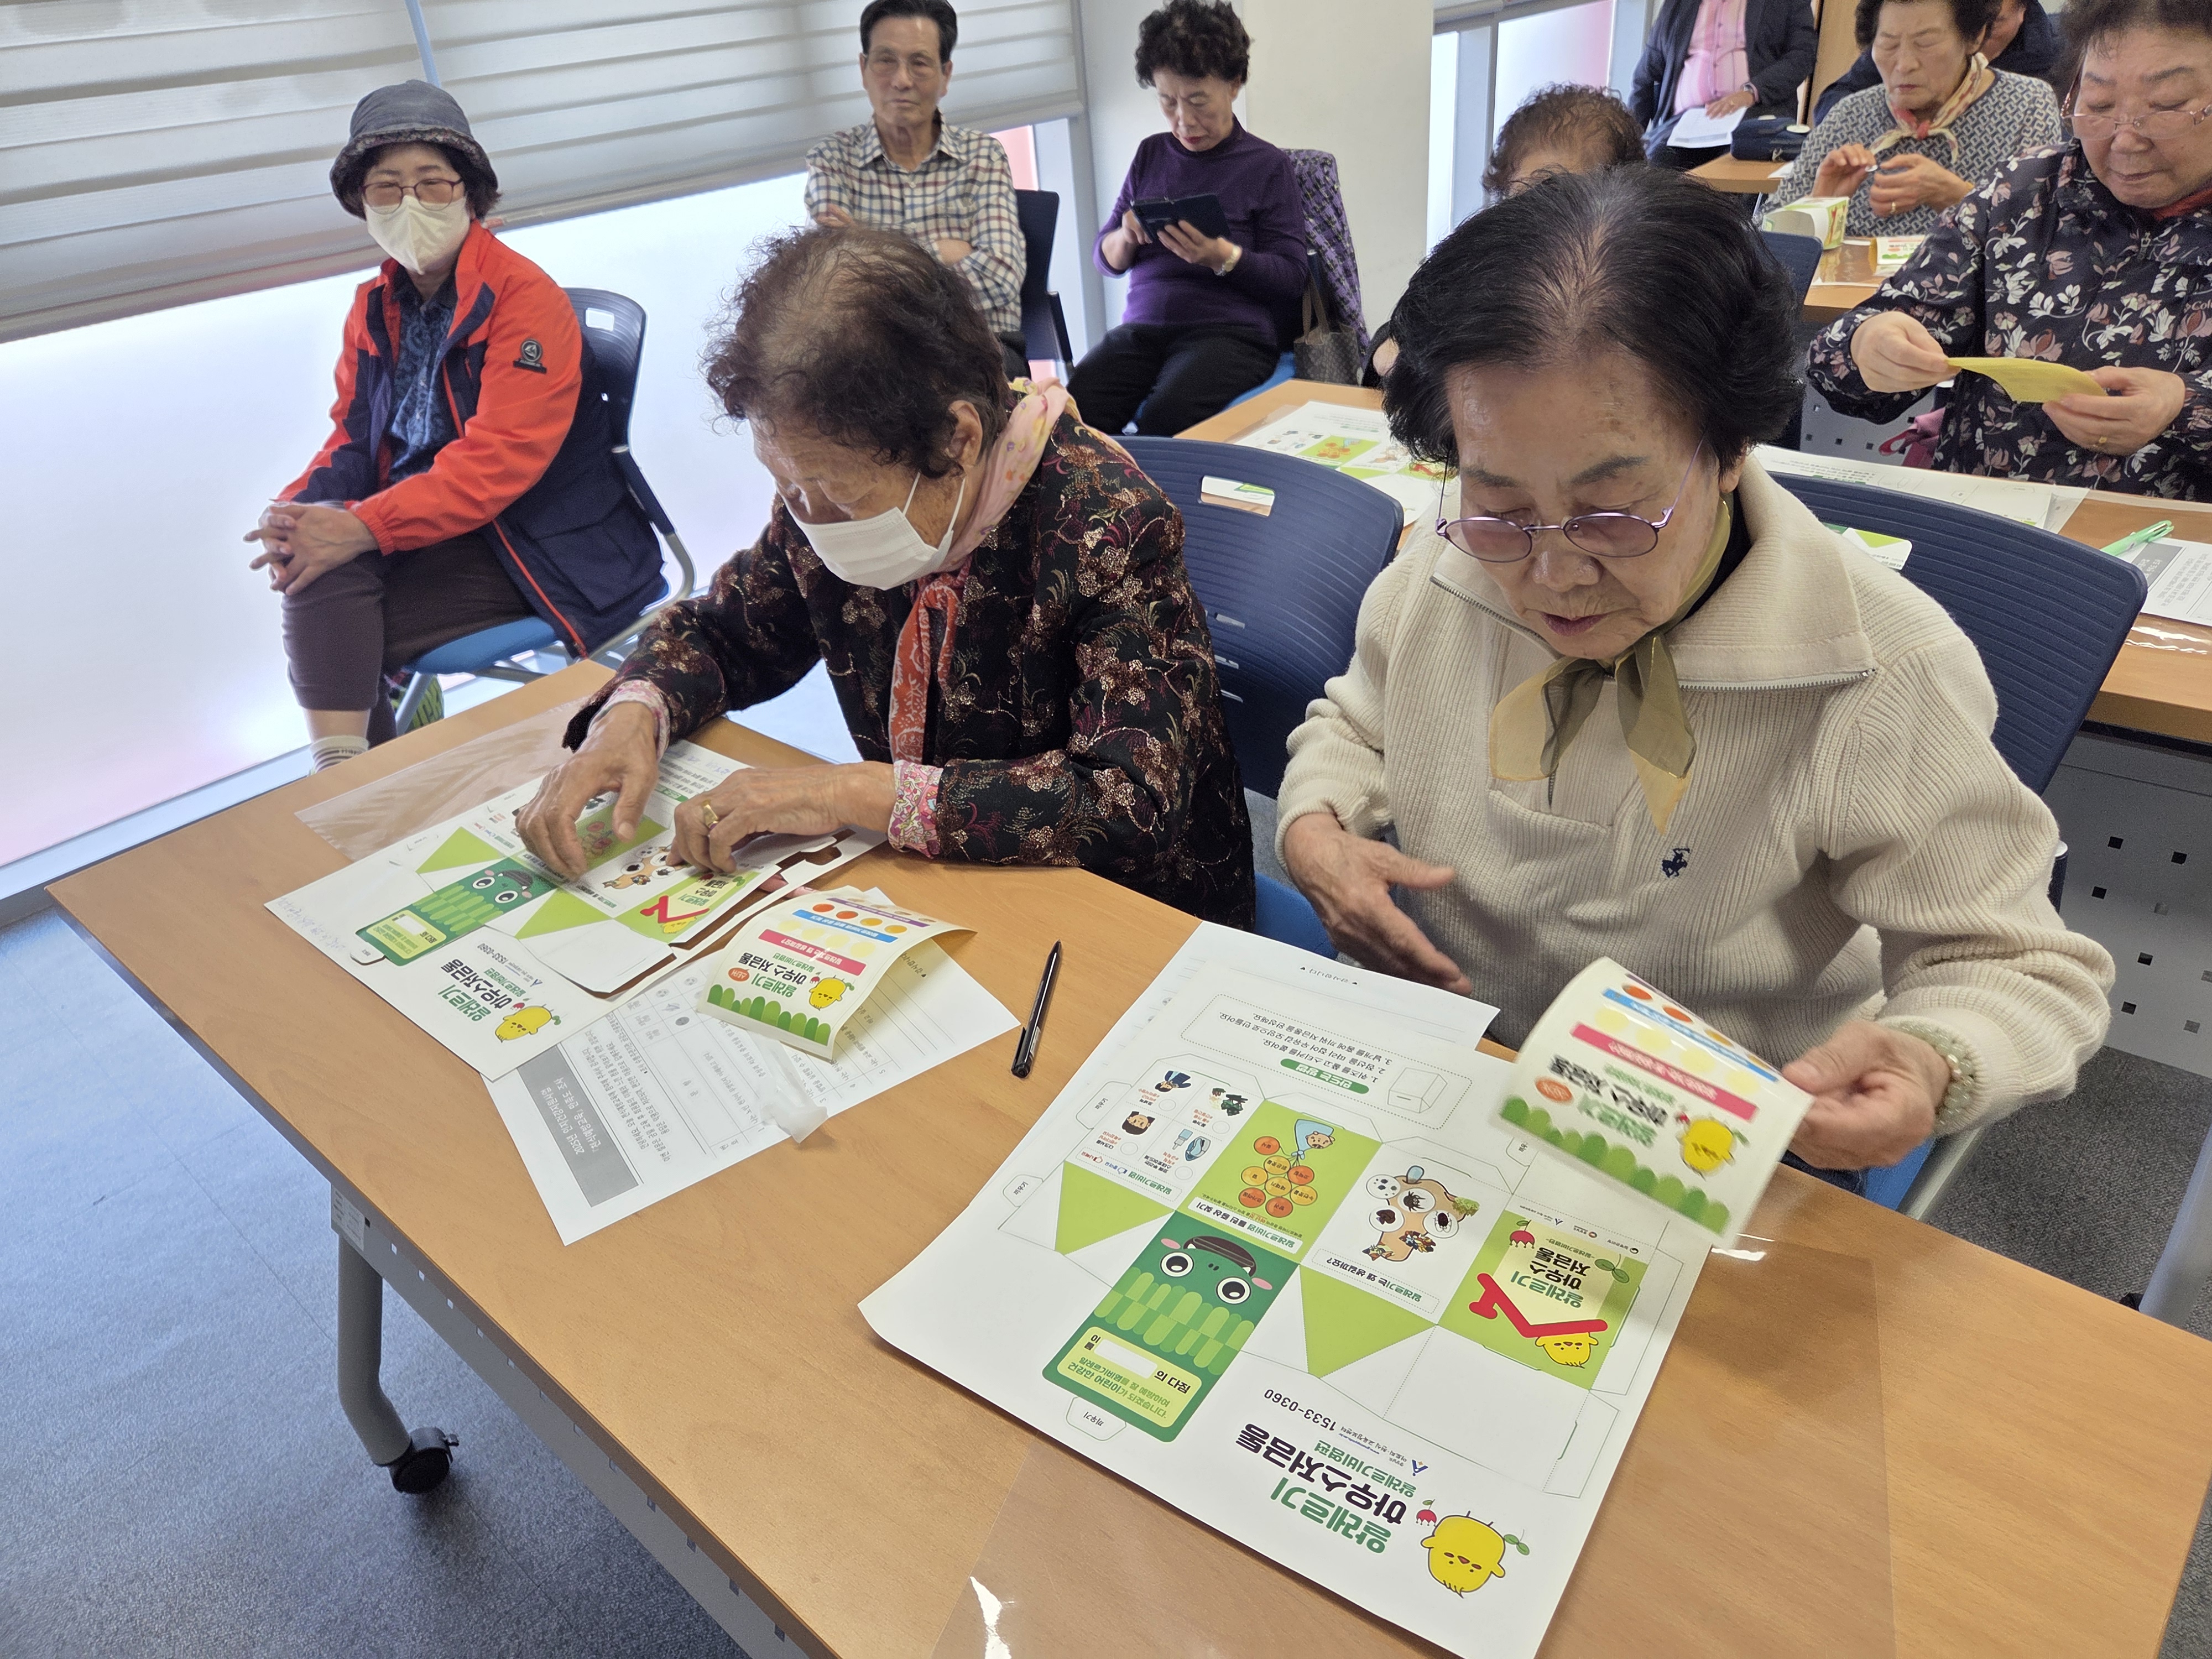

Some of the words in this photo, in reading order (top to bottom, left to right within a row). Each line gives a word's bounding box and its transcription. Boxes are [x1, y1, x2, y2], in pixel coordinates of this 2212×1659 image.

[2192, 299, 2212, 310] Col
[738, 953, 774, 972] 저금통
[773, 953, 815, 972] 알레르기비염편
[484, 968, 526, 997] 알레르기비염편
[774, 965, 807, 984] 하우스
[442, 959, 517, 1009] 하우스저금통
[752, 973, 797, 997] 알레르기
[438, 984, 491, 1021] 알레르기
[1220, 1013, 1251, 1028] 만들어요.
[1254, 1014, 1285, 1029] 완성해요.
[1252, 1025, 1284, 1039] 모양으로
[1286, 1025, 1318, 1040] 저금통을
[1264, 1039, 1288, 1052] 붙여요.
[1285, 1036, 1309, 1047] 우유갑
[1310, 1045, 1327, 1055] 접어
[1319, 1037, 1337, 1046] 끼워
[1289, 1048, 1323, 1063] 스티커를
[1328, 1051, 1345, 1061] 따라
[1349, 1058, 1375, 1071] 점선을
[1356, 1050, 1382, 1062] 날개를
[1296, 1064, 1318, 1076] 방법
[1323, 1061, 1340, 1070] 풀고
[1342, 1067, 1368, 1079] 퀴즈를
[554, 1077, 567, 1090] 조사
[1320, 1072, 1352, 1088] 만드는
[562, 1091, 578, 1109] 만족도
[1095, 1098, 1108, 1109] 끼우기
[541, 1087, 573, 1133] 인지건강지원사업
[566, 1134, 585, 1155] 2025년
[1014, 1182, 1028, 1194] 끼우기
[1128, 1171, 1172, 1194] 알레르기비염
[1197, 1202, 1213, 1212] 찾기
[1247, 1224, 1295, 1248] 알레르기비염
[1327, 1258, 1366, 1276] 생길까요?
[1535, 1248, 1590, 1276] 저금통
[1366, 1273, 1377, 1281] 왜
[1530, 1261, 1581, 1290] 하우스
[1378, 1278, 1422, 1302] 알레르기는
[1511, 1271, 1583, 1308] 알레르기
[1068, 1362, 1094, 1379] 건강한
[1094, 1375, 1128, 1396] 어린이가
[1127, 1393, 1166, 1418] 되겠습니다.
[1079, 1357, 1130, 1385] 알레르기비염을
[1129, 1382, 1139, 1391] 잘
[1139, 1387, 1170, 1407] 예방하여
[1155, 1371, 1167, 1381] 의
[1167, 1378, 1191, 1394] 다짐
[1083, 1412, 1104, 1426] 끼우기
[1265, 1390, 1335, 1431] 1533-0360
[1341, 1427, 1375, 1446] 교육정보센터
[1236, 1424, 1413, 1524] 하우스저금통
[1314, 1440, 1416, 1498] 알레르기비염편
[1271, 1477, 1391, 1553] 알레르기
